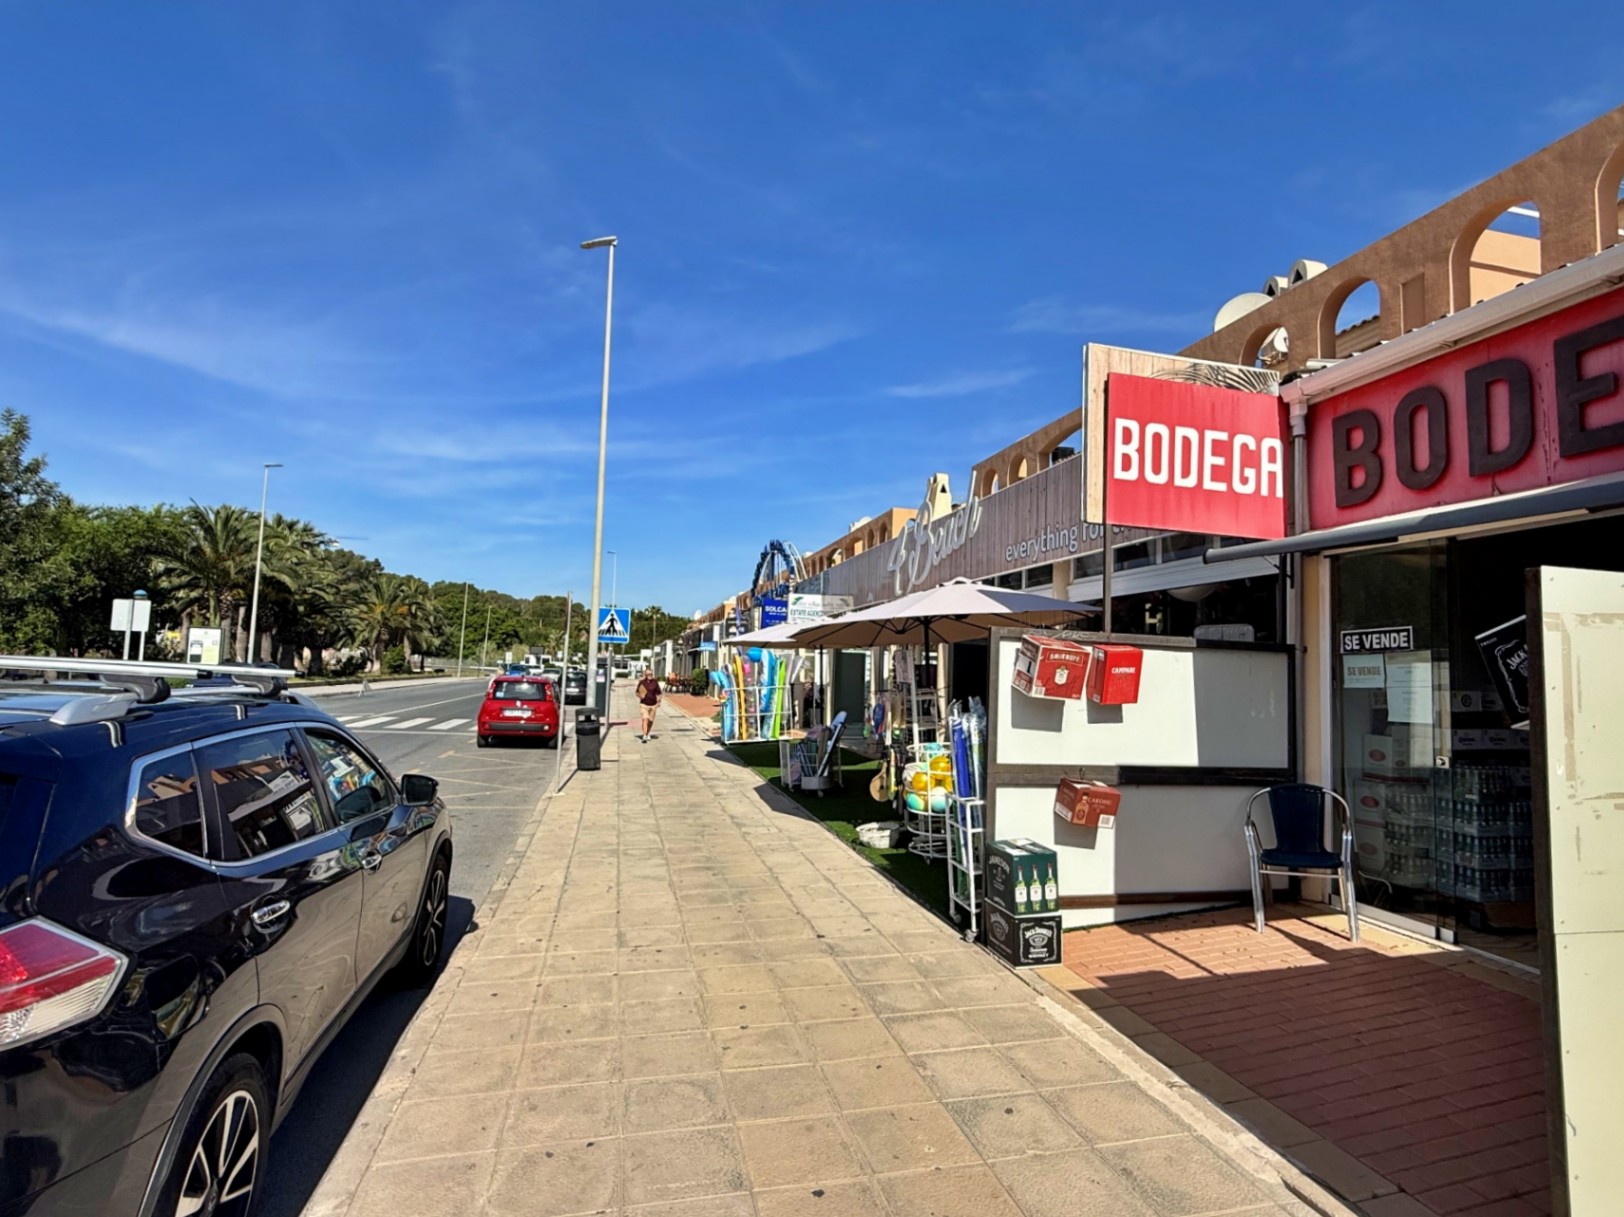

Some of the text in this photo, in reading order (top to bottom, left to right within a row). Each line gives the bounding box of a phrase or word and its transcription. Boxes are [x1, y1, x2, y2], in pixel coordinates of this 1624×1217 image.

[1332, 316, 1624, 508] BODE
[1114, 417, 1284, 498] BODEGA
[907, 470, 983, 595] Beach
[1005, 522, 1079, 562] everything
[1344, 631, 1409, 650] SE VENDE
[1347, 666, 1357, 677] SE
[1358, 665, 1382, 676] VENDE
